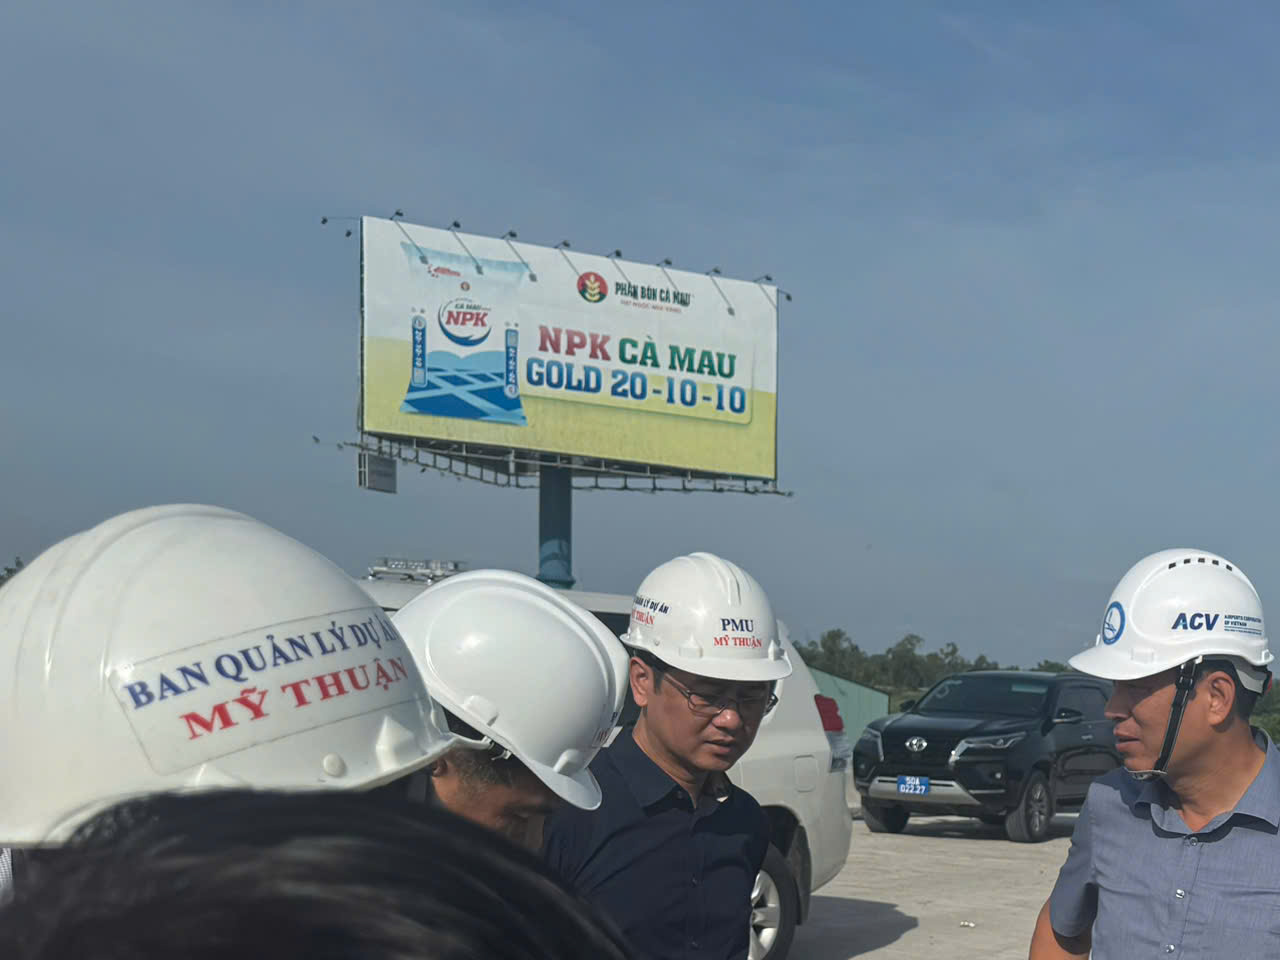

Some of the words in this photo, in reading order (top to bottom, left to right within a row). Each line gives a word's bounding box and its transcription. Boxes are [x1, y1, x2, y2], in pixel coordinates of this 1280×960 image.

[445, 310, 488, 327] NPK
[538, 325, 612, 361] NPK
[618, 335, 661, 369] CÀ
[668, 344, 737, 379] MAU
[526, 357, 603, 394] GOLD
[721, 618, 754, 632] PMU
[1171, 612, 1220, 631] ACV
[713, 634, 730, 647] MỸ
[731, 635, 763, 649] THUẬN
[123, 662, 211, 710] BAN
[214, 634, 314, 683] QUẢN
[310, 620, 351, 656] LÝ
[347, 617, 382, 649] DỰ
[179, 686, 270, 740] MỸ
[280, 657, 409, 708] THUẬN
